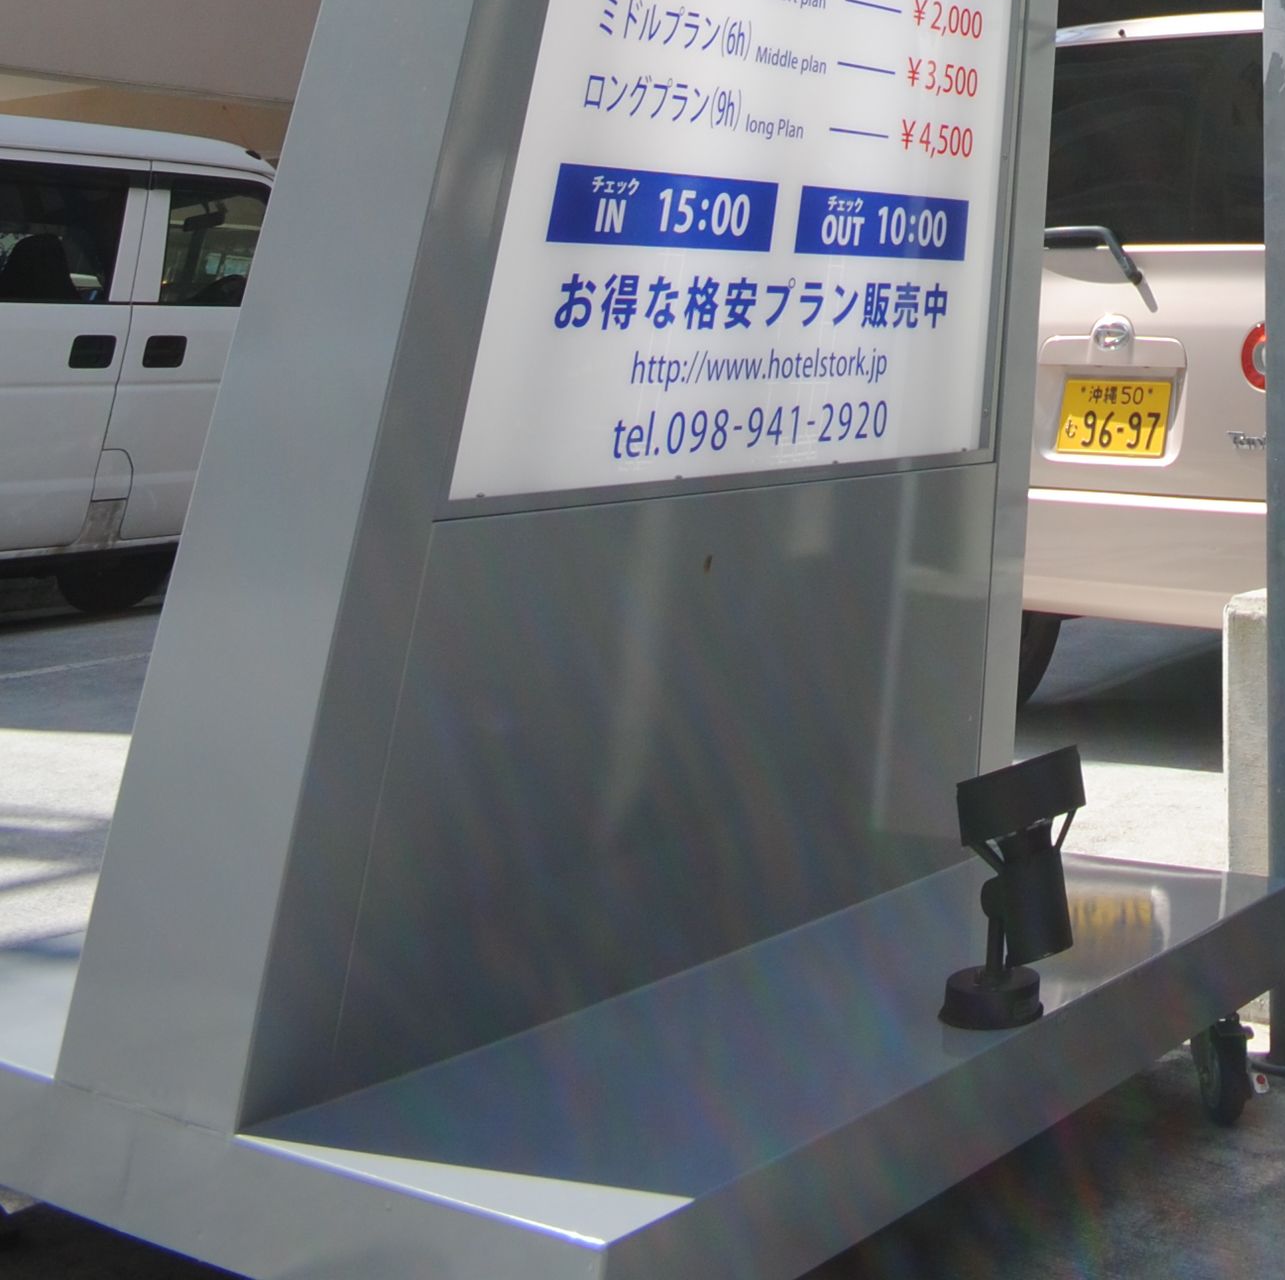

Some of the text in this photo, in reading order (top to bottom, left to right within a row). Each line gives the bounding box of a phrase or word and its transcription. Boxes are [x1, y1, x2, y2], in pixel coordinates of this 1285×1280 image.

[755, 46, 798, 70] Middle
[800, 54, 827, 75] plan
[908, 57, 978, 97] ¥3,500
[745, 113, 775, 138] long
[778, 119, 804, 139] Plan
[901, 119, 973, 159] ¥4,500
[591, 175, 640, 195] チェック
[827, 196, 864, 212] チェック
[595, 188, 751, 236] IN 15:00
[821, 207, 947, 248] OUT 10:00
[553, 273, 949, 330] お得な格安プラン販売中
[630, 348, 888, 391] http://www.hotelstork.jp
[1088, 386, 1117, 404] 沖縄
[1081, 410, 1161, 450] 96-97
